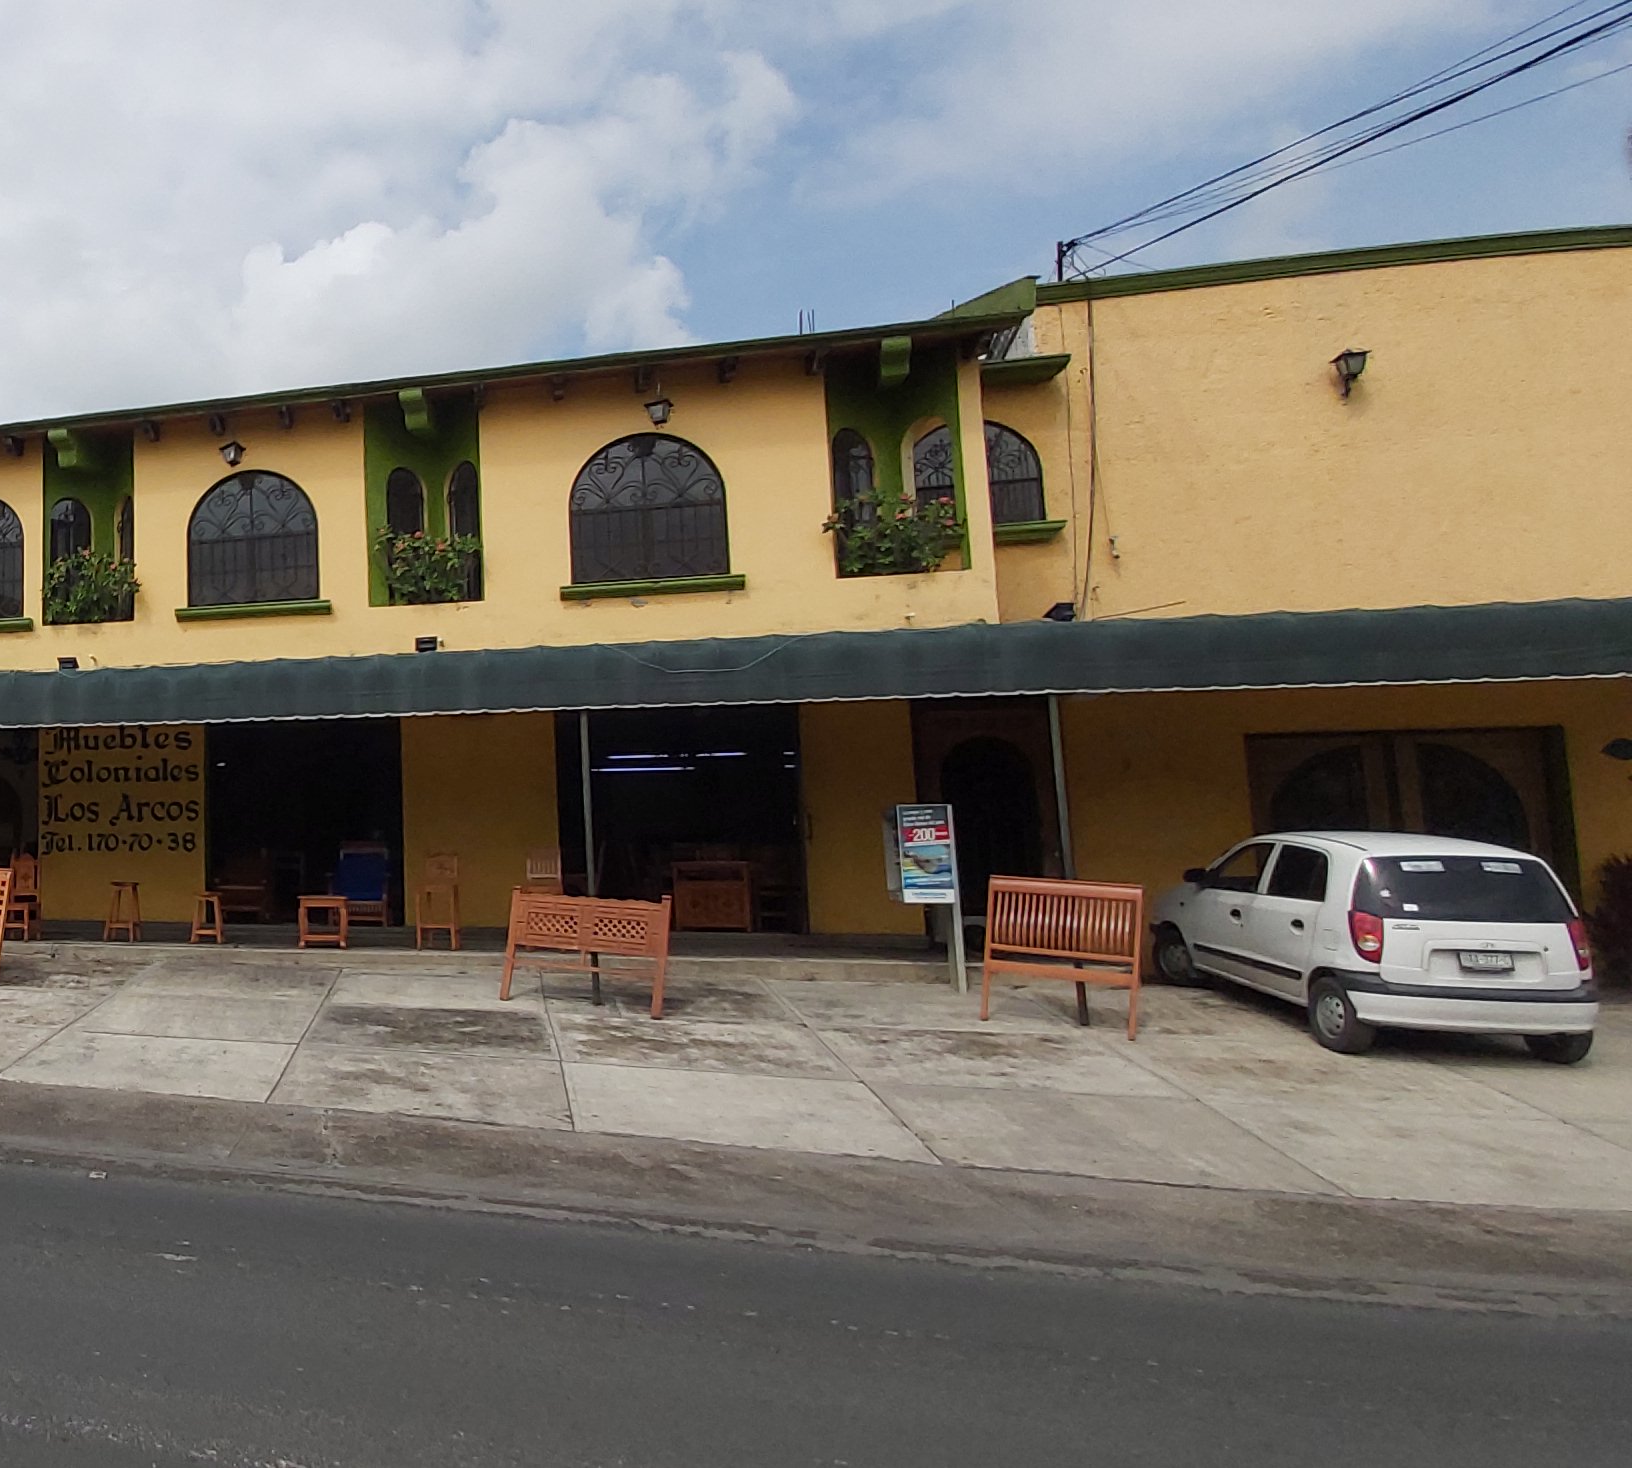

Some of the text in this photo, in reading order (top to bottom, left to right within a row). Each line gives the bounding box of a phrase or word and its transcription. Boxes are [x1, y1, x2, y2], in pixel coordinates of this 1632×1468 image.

[44, 724, 193, 755] Muebles
[42, 755, 200, 788] Coloniales
[42, 793, 200, 826] Los Arcos
[41, 831, 82, 856] Tel.
